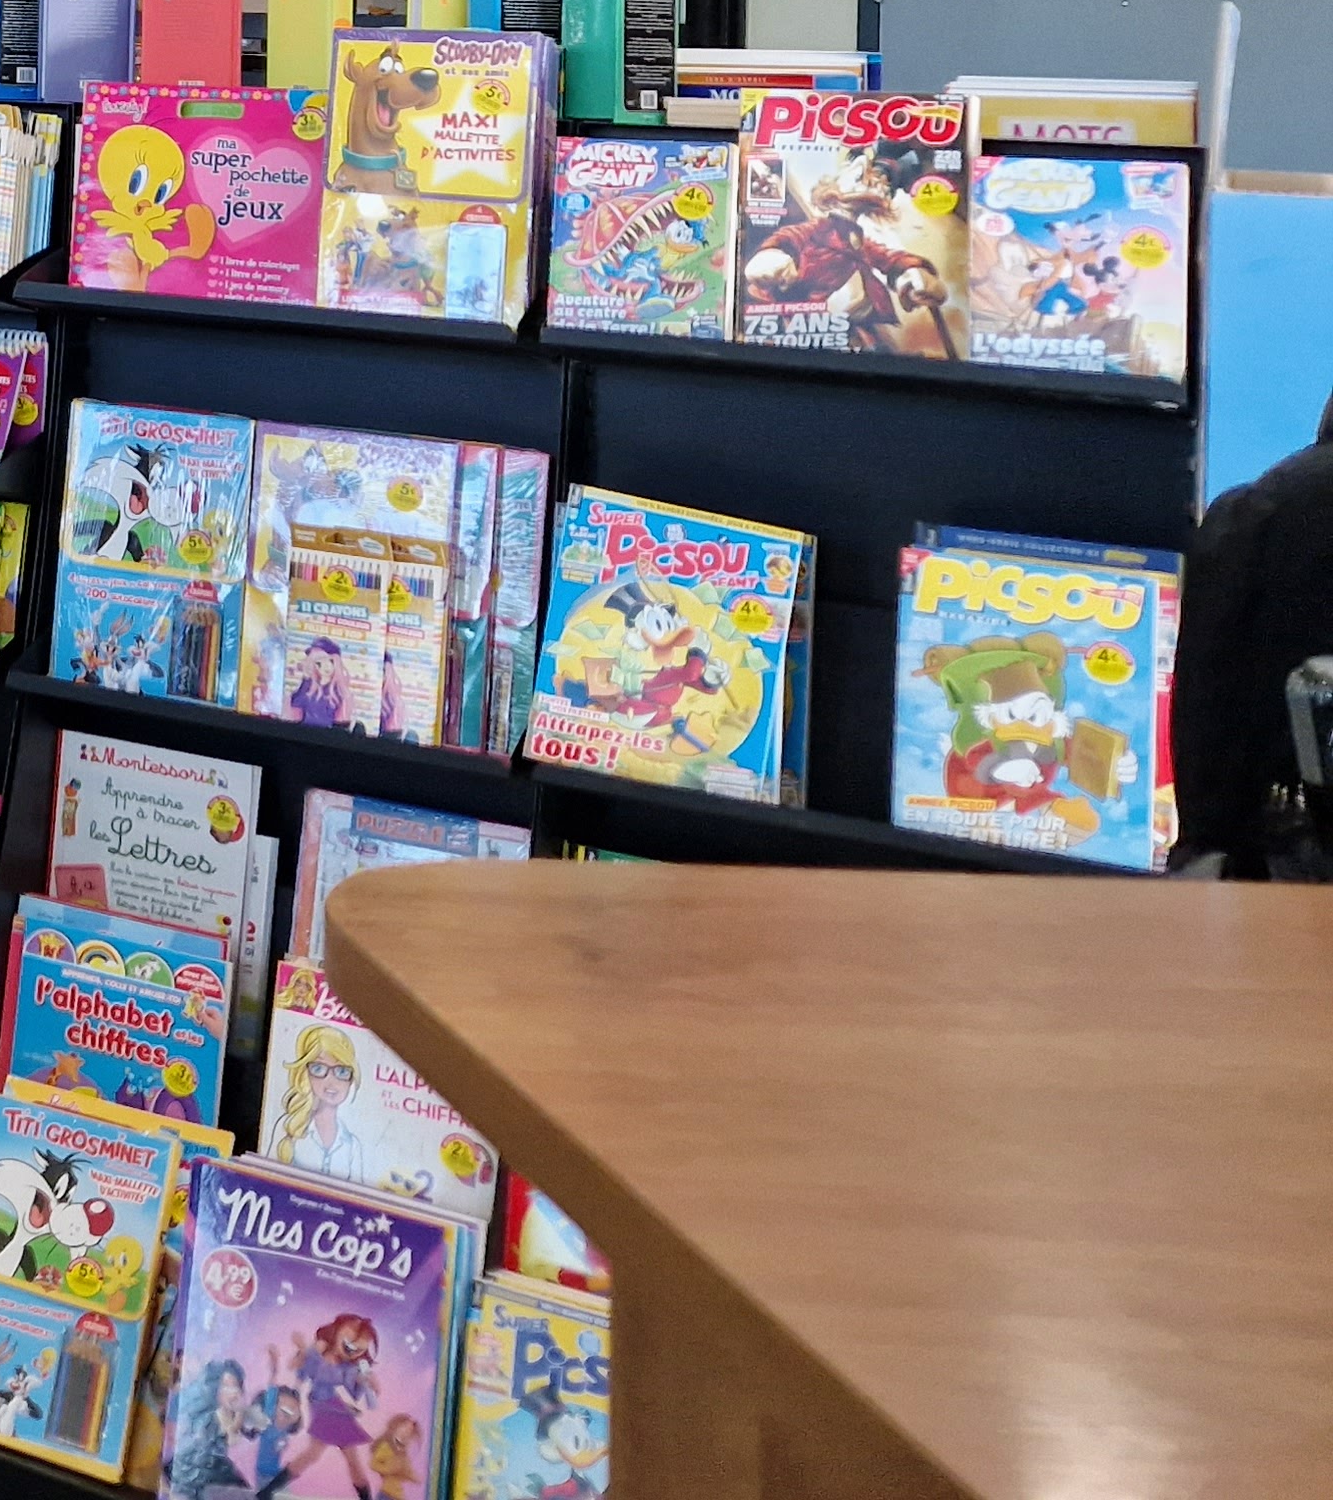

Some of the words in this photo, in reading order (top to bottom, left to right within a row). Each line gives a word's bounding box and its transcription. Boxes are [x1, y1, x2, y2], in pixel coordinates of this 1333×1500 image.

[440, 112, 500, 129] MAXI
[215, 137, 237, 150] ma
[433, 130, 501, 145] MALLETTE
[191, 150, 252, 172] super
[573, 144, 658, 163] MICKEY
[229, 168, 309, 186] pochette
[233, 186, 251, 198] de
[217, 198, 284, 227] jeux
[554, 294, 624, 308] Aventure
[787, 302, 826, 314] PICSOU
[555, 308, 575, 319] au
[578, 308, 627, 320] centre
[744, 315, 781, 334] 75
[785, 314, 851, 334] ANS
[973, 332, 1106, 355] L'odyssée
[588, 502, 644, 527] SUPER
[534, 713, 665, 754] Attrapez-les
[531, 731, 600, 765] tous
[98, 746, 211, 784] Montessori
[101, 778, 185, 811] Apprendre
[152, 811, 201, 831] tracer
[943, 810, 1007, 831] ROUTE
[1009, 813, 1067, 833] POUR
[107, 816, 217, 875] Lettres
[34, 977, 174, 1035] l'alphabet
[66, 1023, 168, 1068] chiffres
[42, 1121, 158, 1170] GROSMINET
[217, 1182, 306, 1250] Mes
[309, 1222, 416, 1281] Cop's
